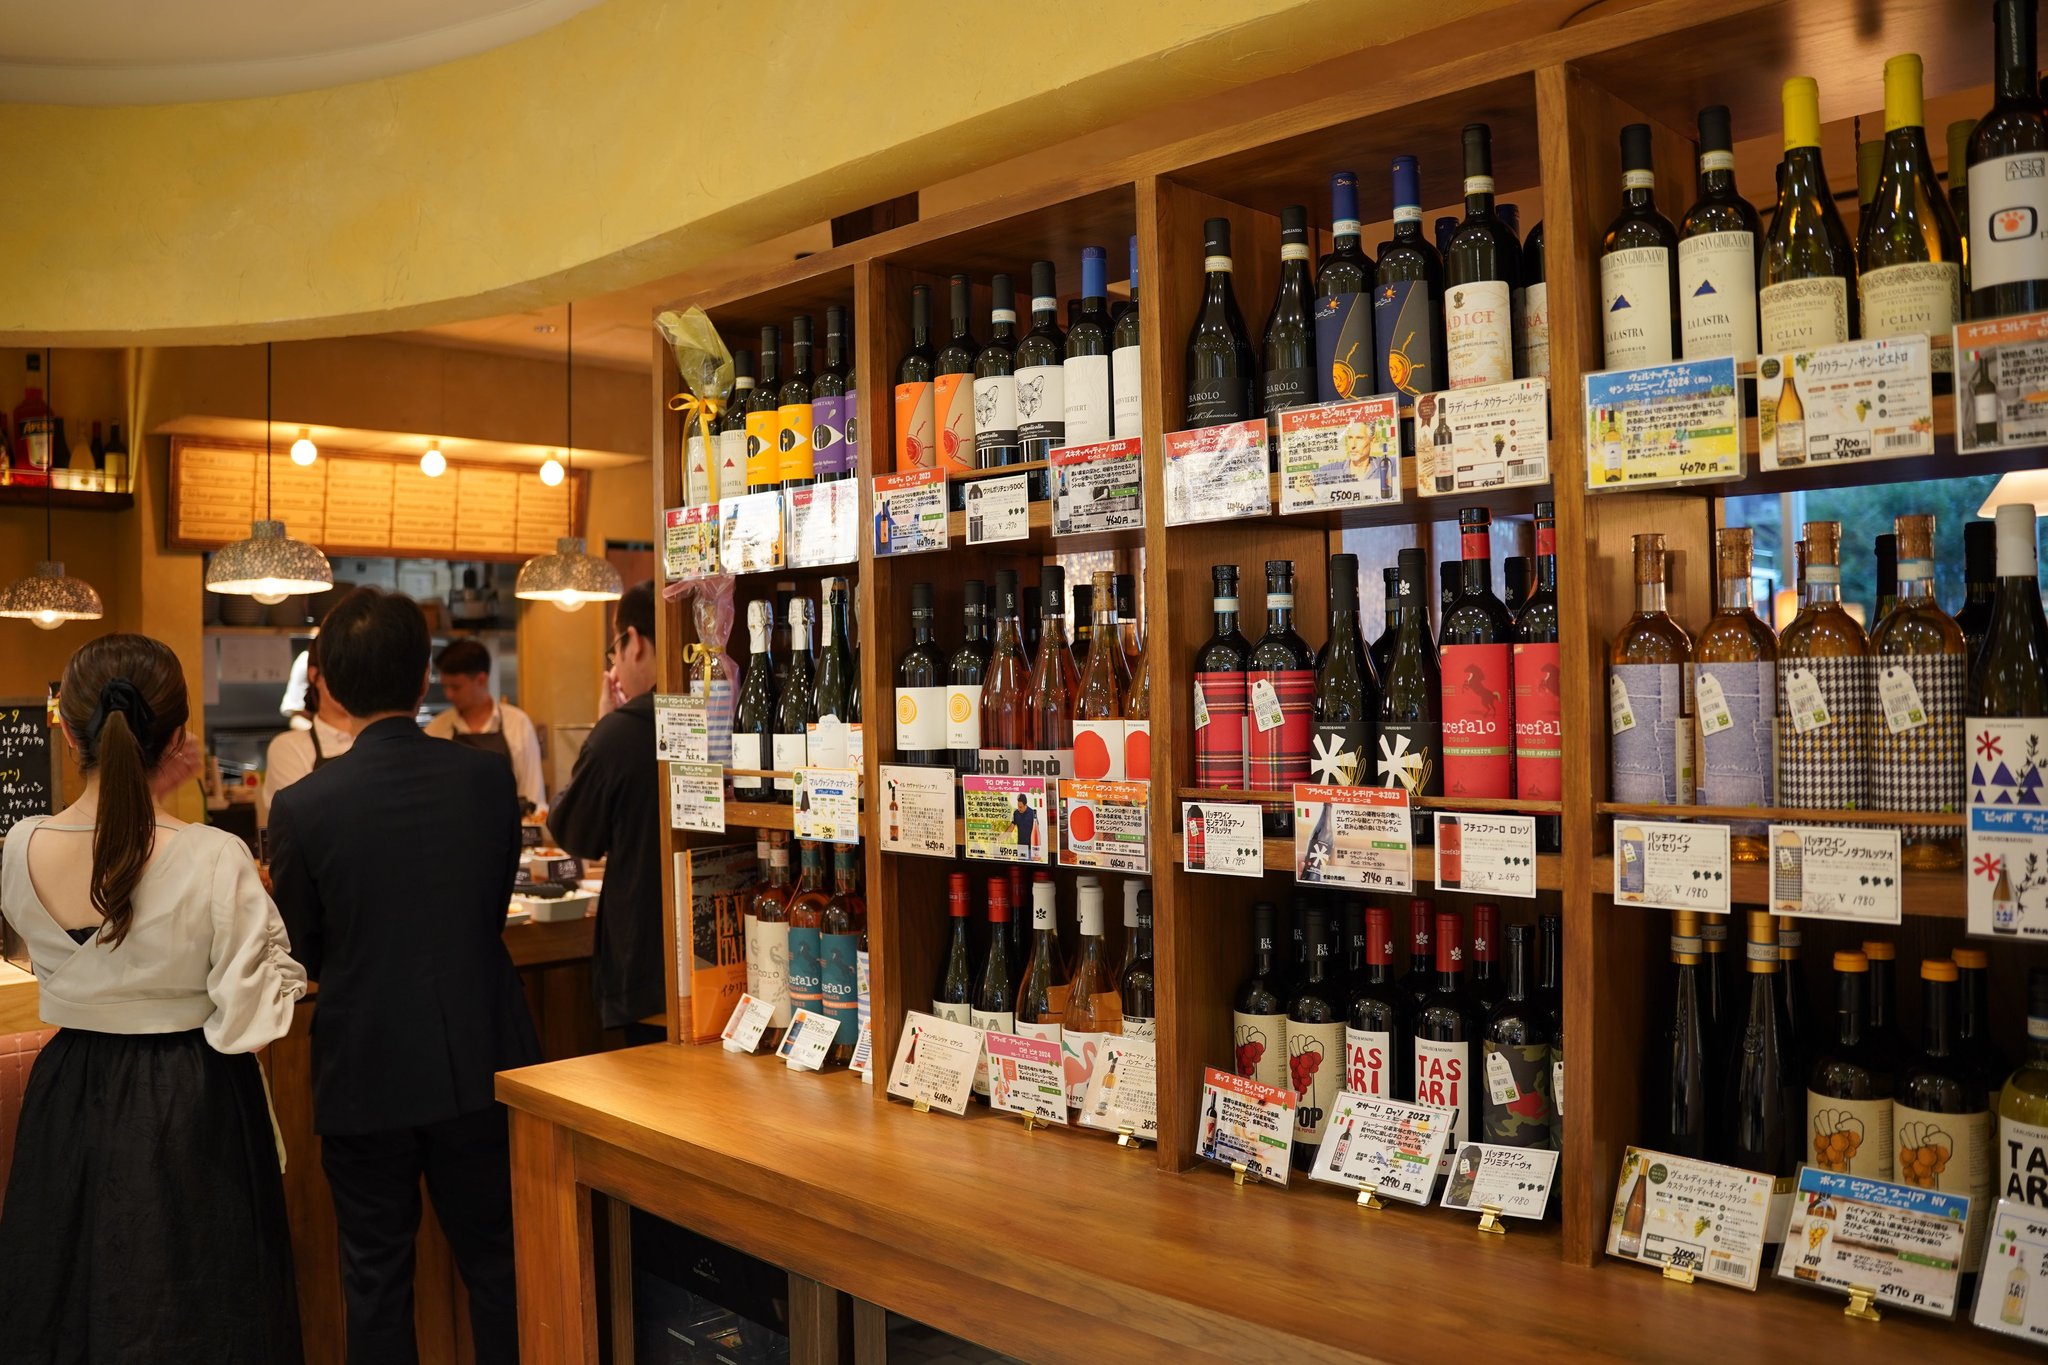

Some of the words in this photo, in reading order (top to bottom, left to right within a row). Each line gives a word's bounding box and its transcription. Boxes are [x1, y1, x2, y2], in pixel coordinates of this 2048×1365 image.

[1697, 314, 1730, 329] LASTRA
[1889, 312, 1932, 326] CLIVI
[1612, 328, 1644, 342] LASTRA
[1776, 327, 1814, 339] CLIVI
[1266, 382, 1298, 394] BAROLO
[1667, 377, 1690, 388] 2024
[1189, 391, 1220, 404] BAROLO
[1292, 414, 1309, 423] ロッソ
[1365, 403, 1383, 414] 2023
[1111, 442, 1127, 451] 2023
[1206, 811, 1231, 819] パッチワイン
[1206, 819, 1245, 827] モンテプルチアーノ
[1464, 823, 1506, 834] ブチェファーロ
[1510, 826, 1529, 835] ロッソ
[1647, 832, 1692, 843] パッチワイン
[1804, 836, 1847, 847] パッチワイン
[1647, 843, 1690, 853] パッセリーナ
[1686, 887, 1708, 899] 1980
[1853, 895, 1876, 907] 1980
[1418, 1054, 1461, 1081] TAS
[1418, 1080, 1458, 1107] ARI
[1356, 1102, 1381, 1112] タサーリ
[1385, 1107, 1404, 1116] ロッソ
[1408, 1111, 1431, 1122] 2023
[1485, 1149, 1524, 1160] パッチワイン
[1483, 1158, 1532, 1170] プリミティーヴォ
[1820, 1175, 1846, 1189] ポップ
[1850, 1181, 1887, 1196] ビアンコ
[1890, 1188, 1926, 1203] プーリア
[1931, 1196, 1947, 1208] NV
[1508, 1195, 1530, 1206] 1980
[1804, 1254, 1822, 1267] POP
[1879, 1283, 1910, 1299] 2970
